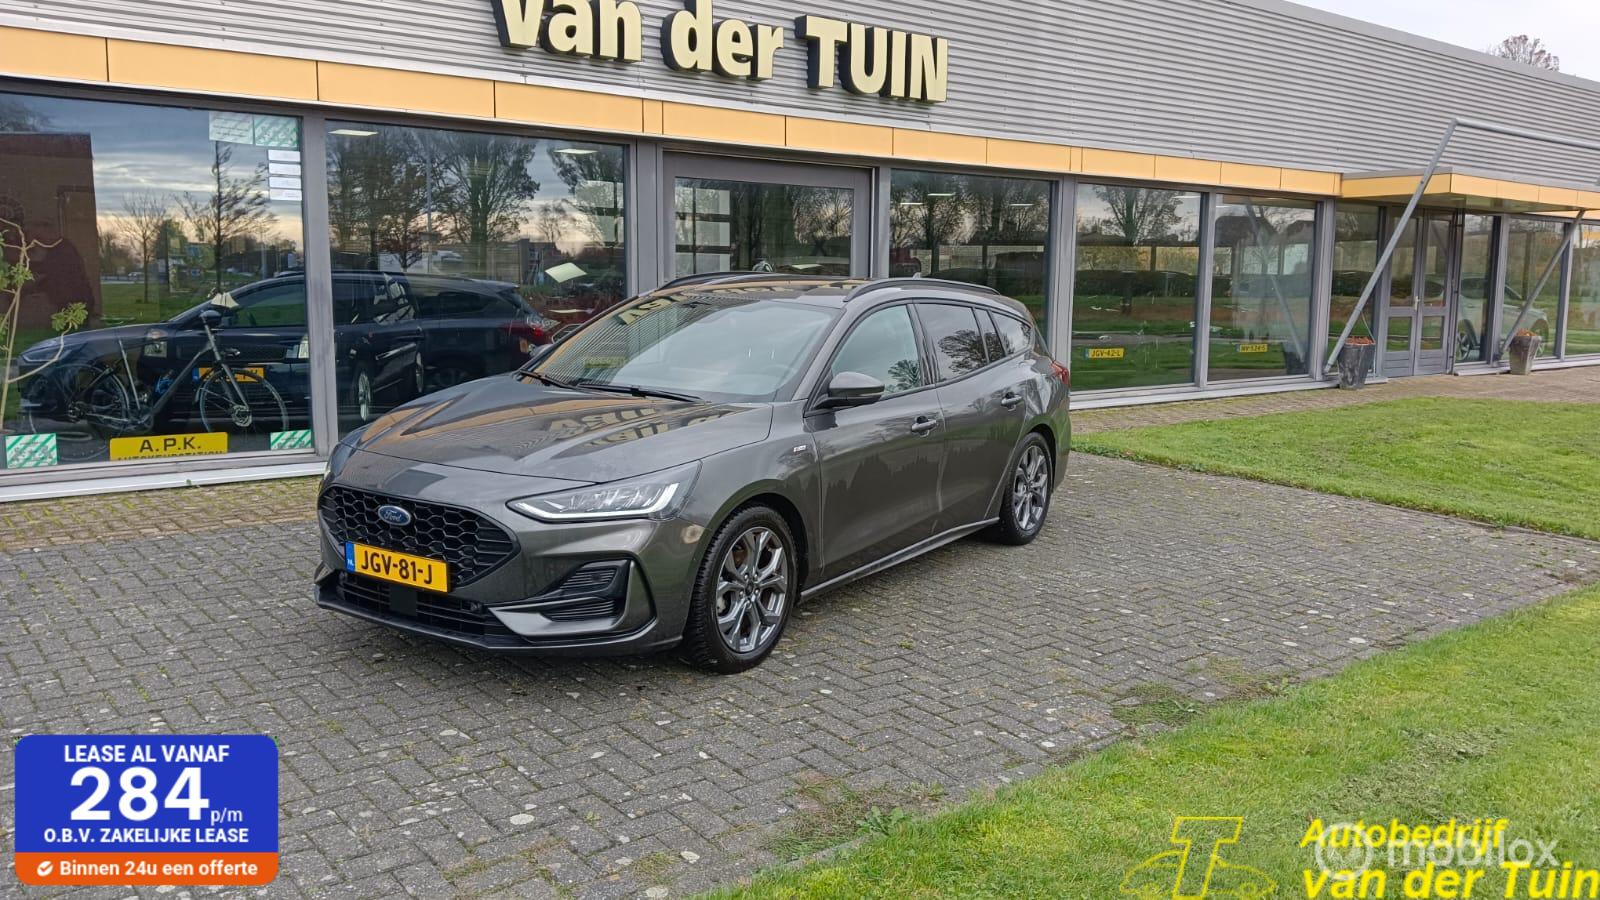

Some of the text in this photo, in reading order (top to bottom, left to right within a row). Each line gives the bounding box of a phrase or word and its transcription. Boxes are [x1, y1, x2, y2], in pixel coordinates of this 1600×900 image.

[671, 0, 784, 79] der
[803, 15, 949, 103] TUIN
[139, 436, 202, 453] A.P.K.
[361, 550, 433, 585] JGV-81-J
